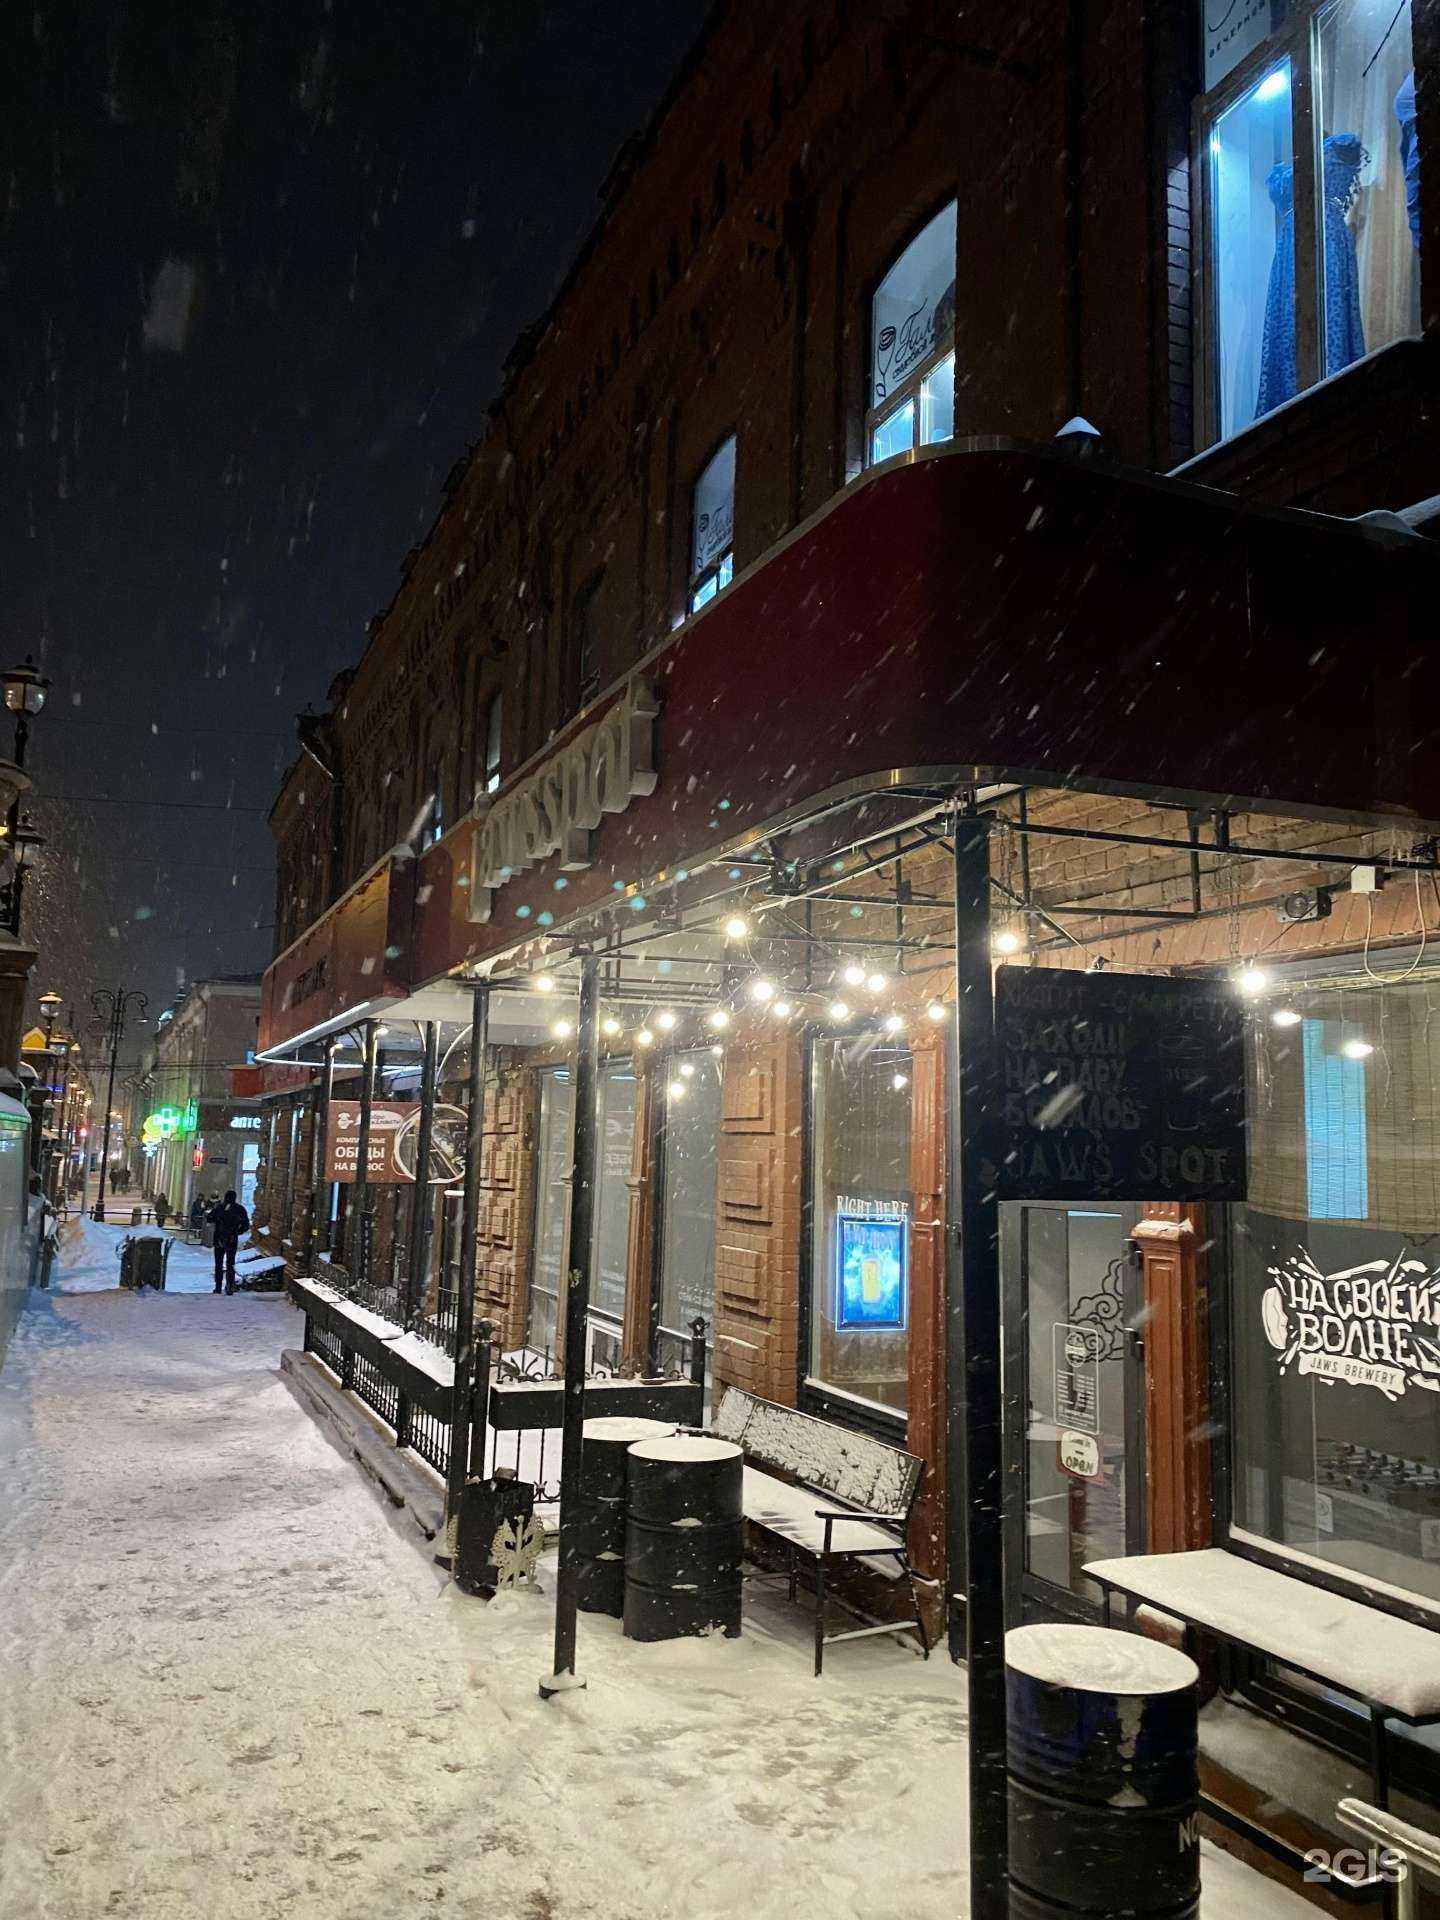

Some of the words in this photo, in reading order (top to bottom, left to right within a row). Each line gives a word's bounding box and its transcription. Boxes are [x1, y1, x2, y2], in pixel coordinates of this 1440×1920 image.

[1004, 1092, 1141, 1131] БОАЛОВ
[334, 1163, 348, 1171] НА
[837, 1195, 871, 1221] RIGHT
[874, 1199, 908, 1222] HERE
[1310, 1357, 1338, 1374] JAWS
[1344, 1364, 1397, 1385] BREWERY
[1066, 1456, 1094, 1473] OPEN
